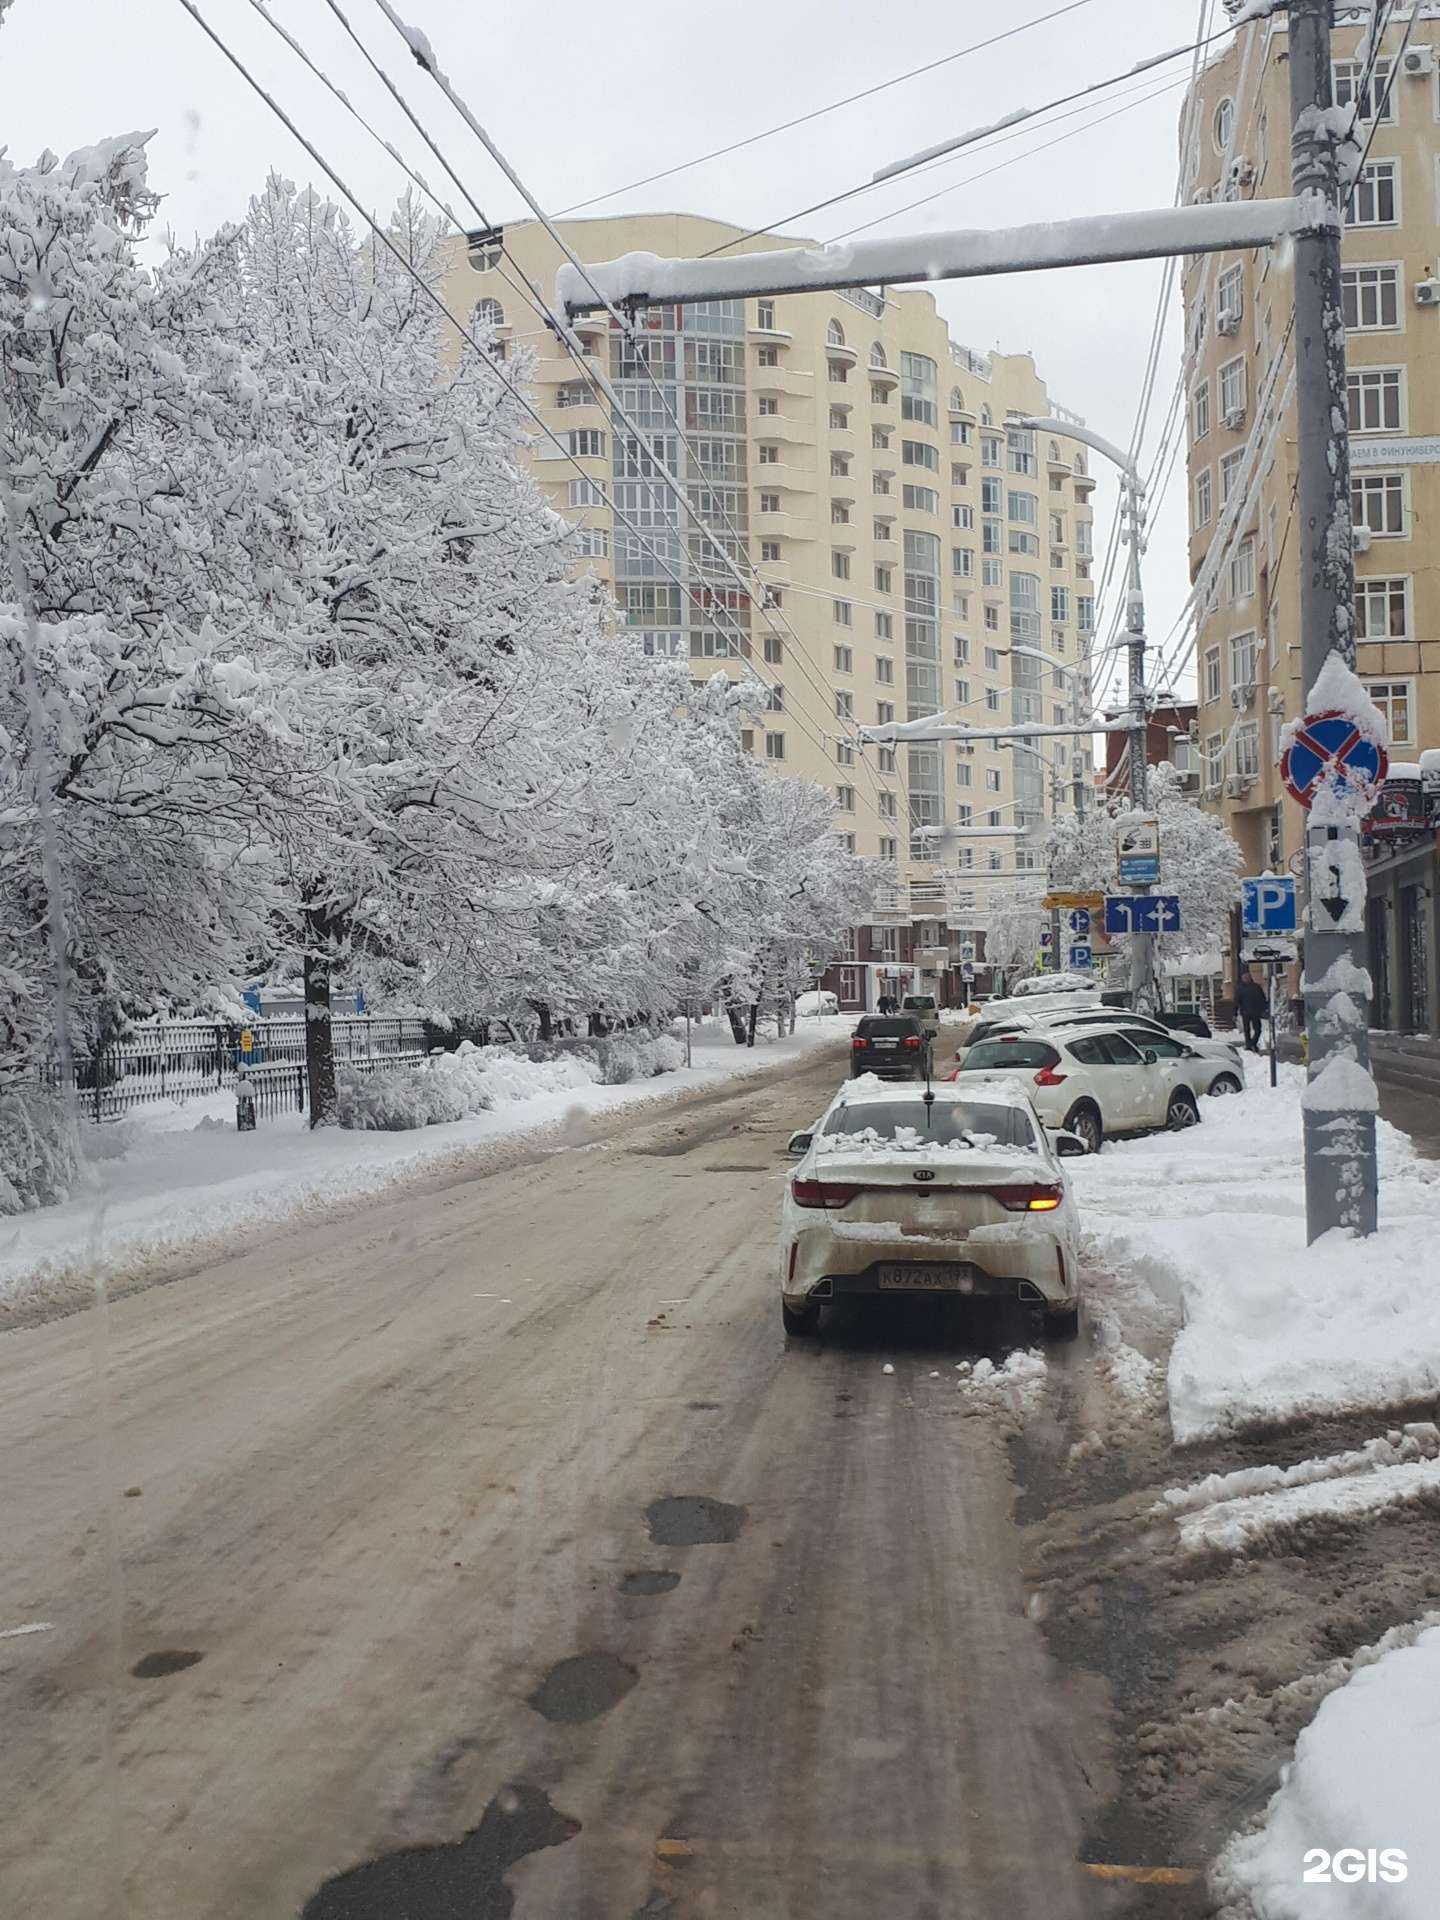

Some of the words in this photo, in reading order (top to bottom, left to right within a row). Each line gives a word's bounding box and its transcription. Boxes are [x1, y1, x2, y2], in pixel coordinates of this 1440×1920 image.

[1257, 884, 1286, 926] P
[1075, 949, 1088, 966] P
[915, 1171, 933, 1180] KIA
